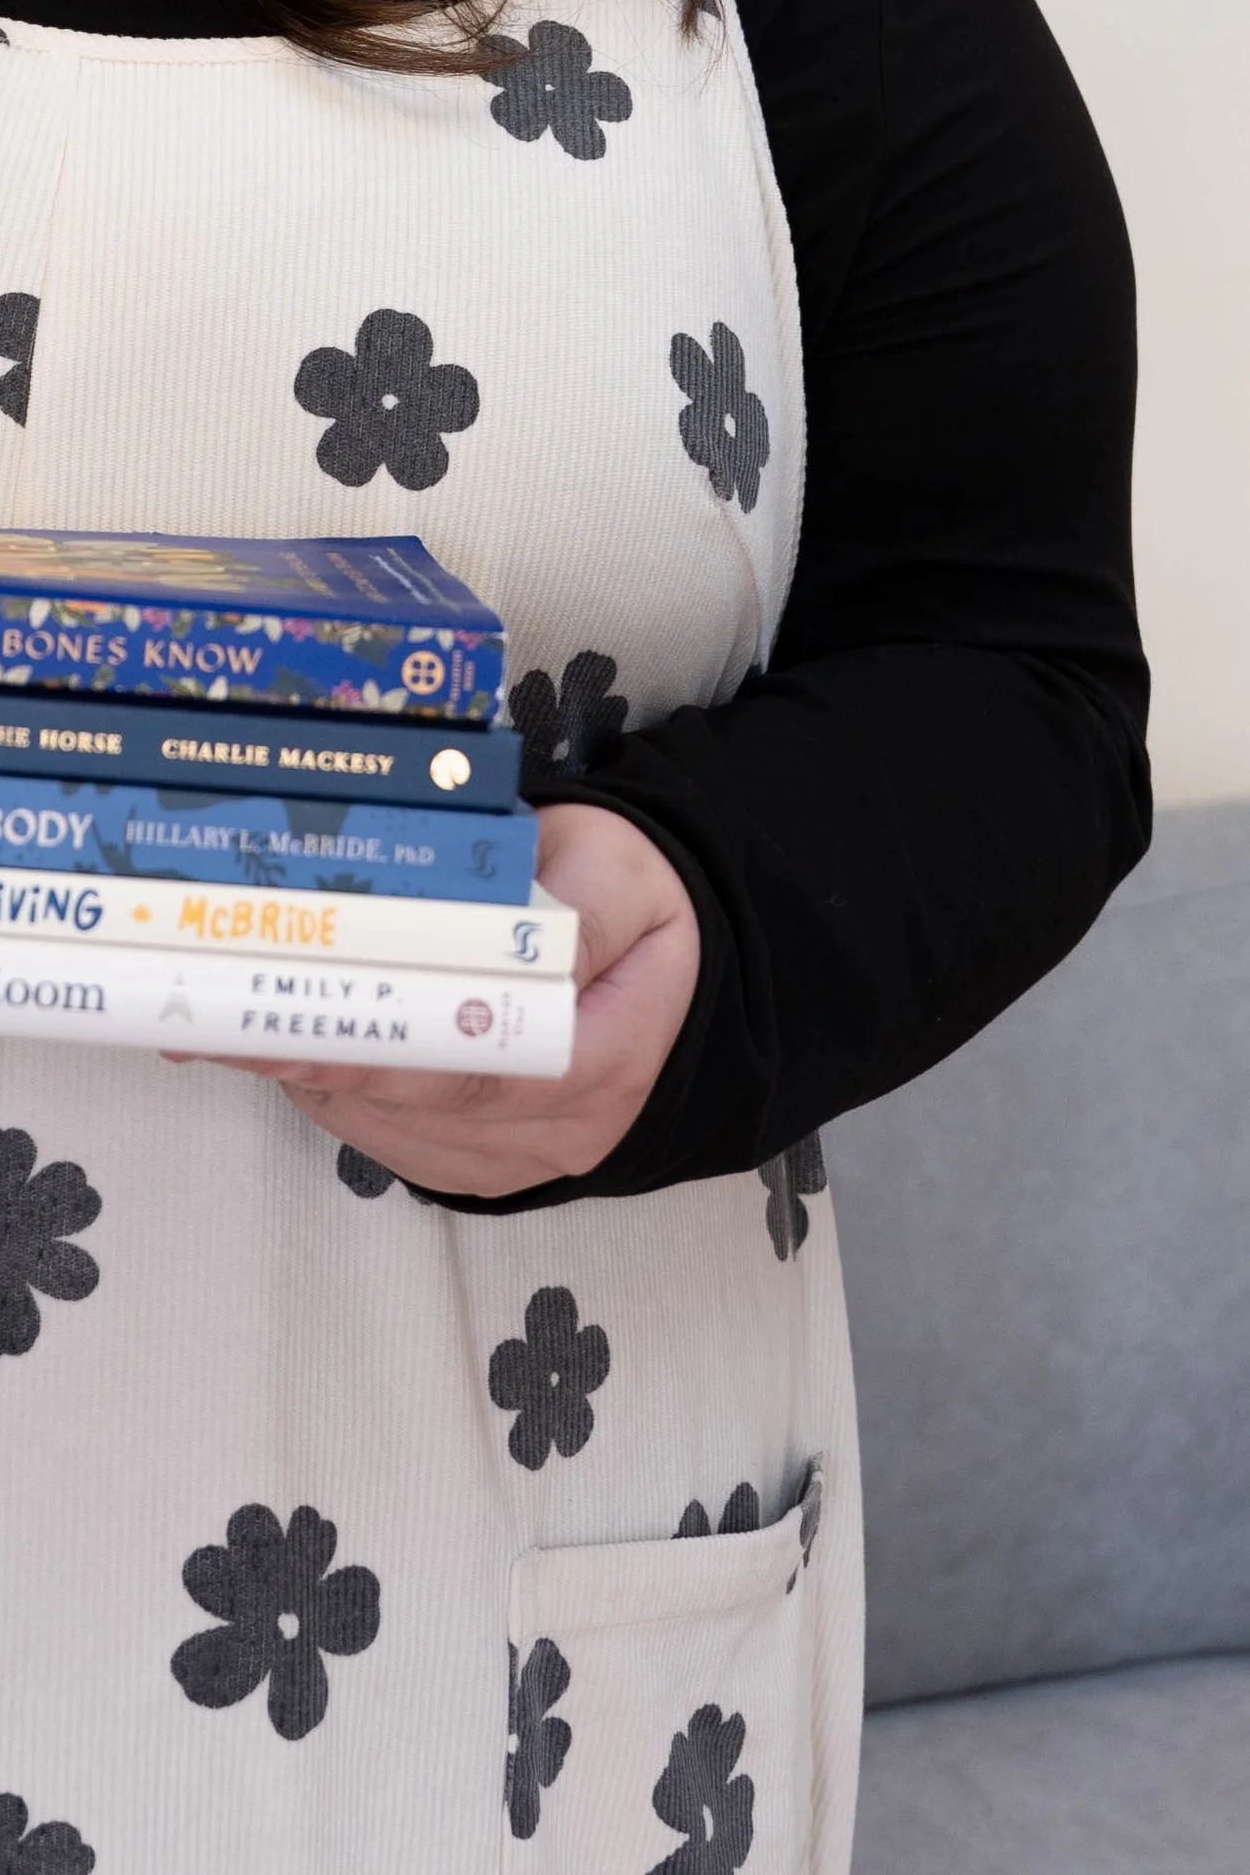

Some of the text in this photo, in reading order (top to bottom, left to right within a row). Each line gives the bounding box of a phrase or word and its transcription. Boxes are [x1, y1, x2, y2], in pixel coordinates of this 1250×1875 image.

[1, 628, 128, 667] BONES
[142, 639, 263, 677] KNOW
[38, 728, 123, 755] HORSE
[161, 738, 395, 776] CHARLIE MACKESY
[125, 820, 231, 851] HILLARY
[251, 973, 405, 1005] EMILY P.
[241, 1010, 409, 1043] FREEMAN
